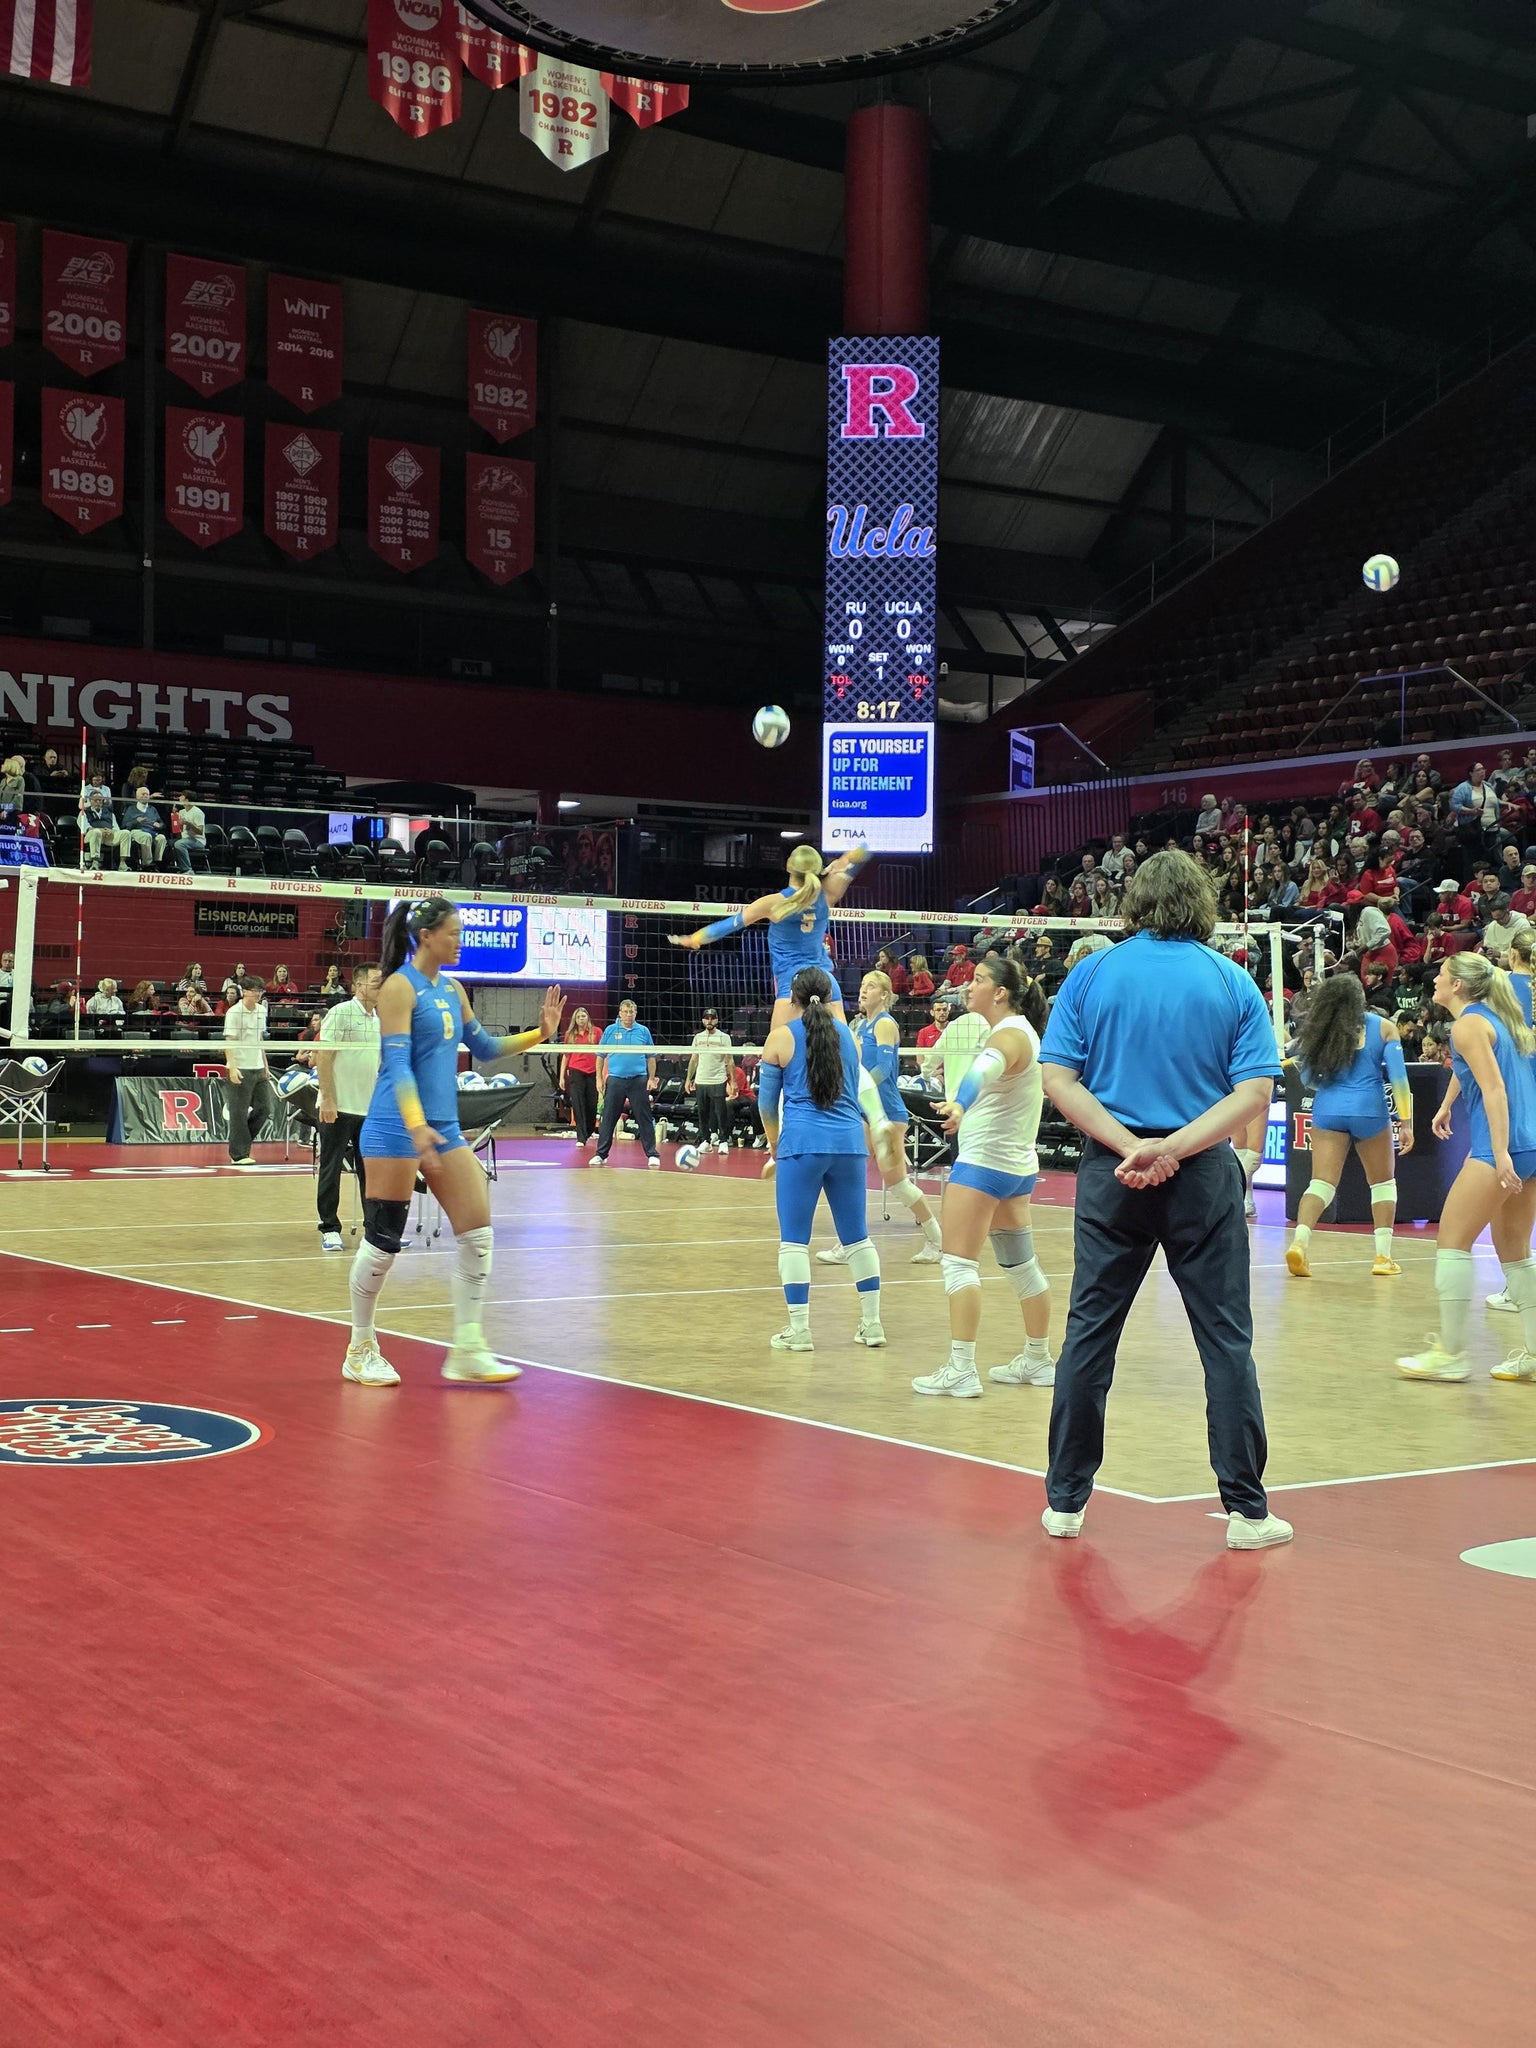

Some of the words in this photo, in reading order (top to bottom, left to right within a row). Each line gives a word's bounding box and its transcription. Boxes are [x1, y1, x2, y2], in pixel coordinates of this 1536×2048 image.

[398, 0, 440, 19] NCAA
[397, 32, 440, 50] WOMEN'S
[455, 32, 486, 48] SWEET
[392, 40, 445, 60] BASKETBALL
[486, 53, 501, 71] R
[377, 51, 451, 93] 1986
[547, 69, 587, 86] WOMEN'S
[542, 77, 592, 97] BASKETBALL
[616, 75, 640, 88] ELITE
[643, 81, 670, 96] EIGHT
[388, 86, 413, 99] ELITE
[416, 94, 444, 106] EIGHT
[637, 92, 652, 111] R
[409, 105, 425, 123] R
[528, 89, 597, 128] 1982
[538, 121, 590, 140] CHAMPIONS
[558, 138, 574, 156] R
[66, 256, 105, 272] BIG
[60, 267, 115, 285] EAST
[190, 280, 226, 294] BIG
[184, 290, 236, 307] EAST
[284, 297, 331, 320] WNIT
[46, 310, 122, 342] 2006
[170, 332, 242, 363] 2007
[277, 341, 303, 354] 2014
[309, 346, 334, 359] 2016
[79, 349, 94, 364] R
[201, 370, 215, 385] R
[301, 386, 314, 401] R
[474, 382, 528, 409] 1982
[841, 363, 925, 439] R
[58, 398, 84, 422] ATLANTIC
[497, 418, 508, 431] R
[60, 455, 107, 470] BASKETBALL
[71, 450, 97, 461] MEN'S
[182, 472, 228, 486] BASKETBALL
[193, 467, 217, 477] MEN'S
[48, 468, 115, 497] 1989
[175, 485, 231, 513] 1991
[275, 491, 300, 502] 1967
[77, 506, 91, 521] R
[275, 501, 300, 512] 1973
[303, 504, 327, 516] 1974
[275, 511, 300, 522] 1977
[198, 522, 211, 536] R
[296, 536, 309, 550] R
[487, 527, 512, 549] 15
[400, 548, 412, 561] R
[494, 560, 506, 573] R
[845, 602, 867, 615] RU
[884, 601, 923, 615] UCLA
[848, 618, 863, 640] 0
[896, 618, 911, 640] 0
[828, 644, 854, 654] WON
[905, 644, 932, 654] WON
[837, 655, 846, 666] 0
[868, 652, 889, 662] SET
[914, 655, 923, 666] 0
[876, 666, 884, 681] 1
[914, 687, 923, 698] 2
[0, 670, 294, 743] NIGHTS
[857, 701, 901, 719] 8:17
[832, 738, 857, 754] SET
[859, 738, 925, 754] YOURSELF
[832, 757, 851, 772] UP
[853, 757, 879, 772] FOR
[832, 776, 913, 791] RETIREMENT
[1161, 787, 1188, 805] 116
[832, 798, 867, 810] tiaa.org
[843, 829, 866, 838] TIAA
[92, 872, 104, 881] R
[138, 874, 194, 886] RUTGERS
[227, 879, 237, 888] R
[270, 881, 323, 893] RUTGERS
[353, 885, 363, 895] R
[394, 888, 444, 899] RUTGERS
[473, 891, 482, 901] R
[510, 893, 558, 905] RUTGERS
[586, 898, 594, 907] R
[621, 900, 666, 910] RUTGERS
[692, 903, 701, 912] R
[502, 909, 523, 927] UP
[889, 911, 897, 919] R
[920, 912, 959, 922] RUTGERS
[981, 915, 988, 924] R
[1011, 917, 1048, 926] RUTGERS
[1070, 918, 1077, 926] R
[224, 923, 249, 933] FLOOR
[250, 924, 270, 933] LOGE
[800, 913, 817, 933] 5
[558, 933, 592, 947] TIAA
[158, 1090, 208, 1131] R
